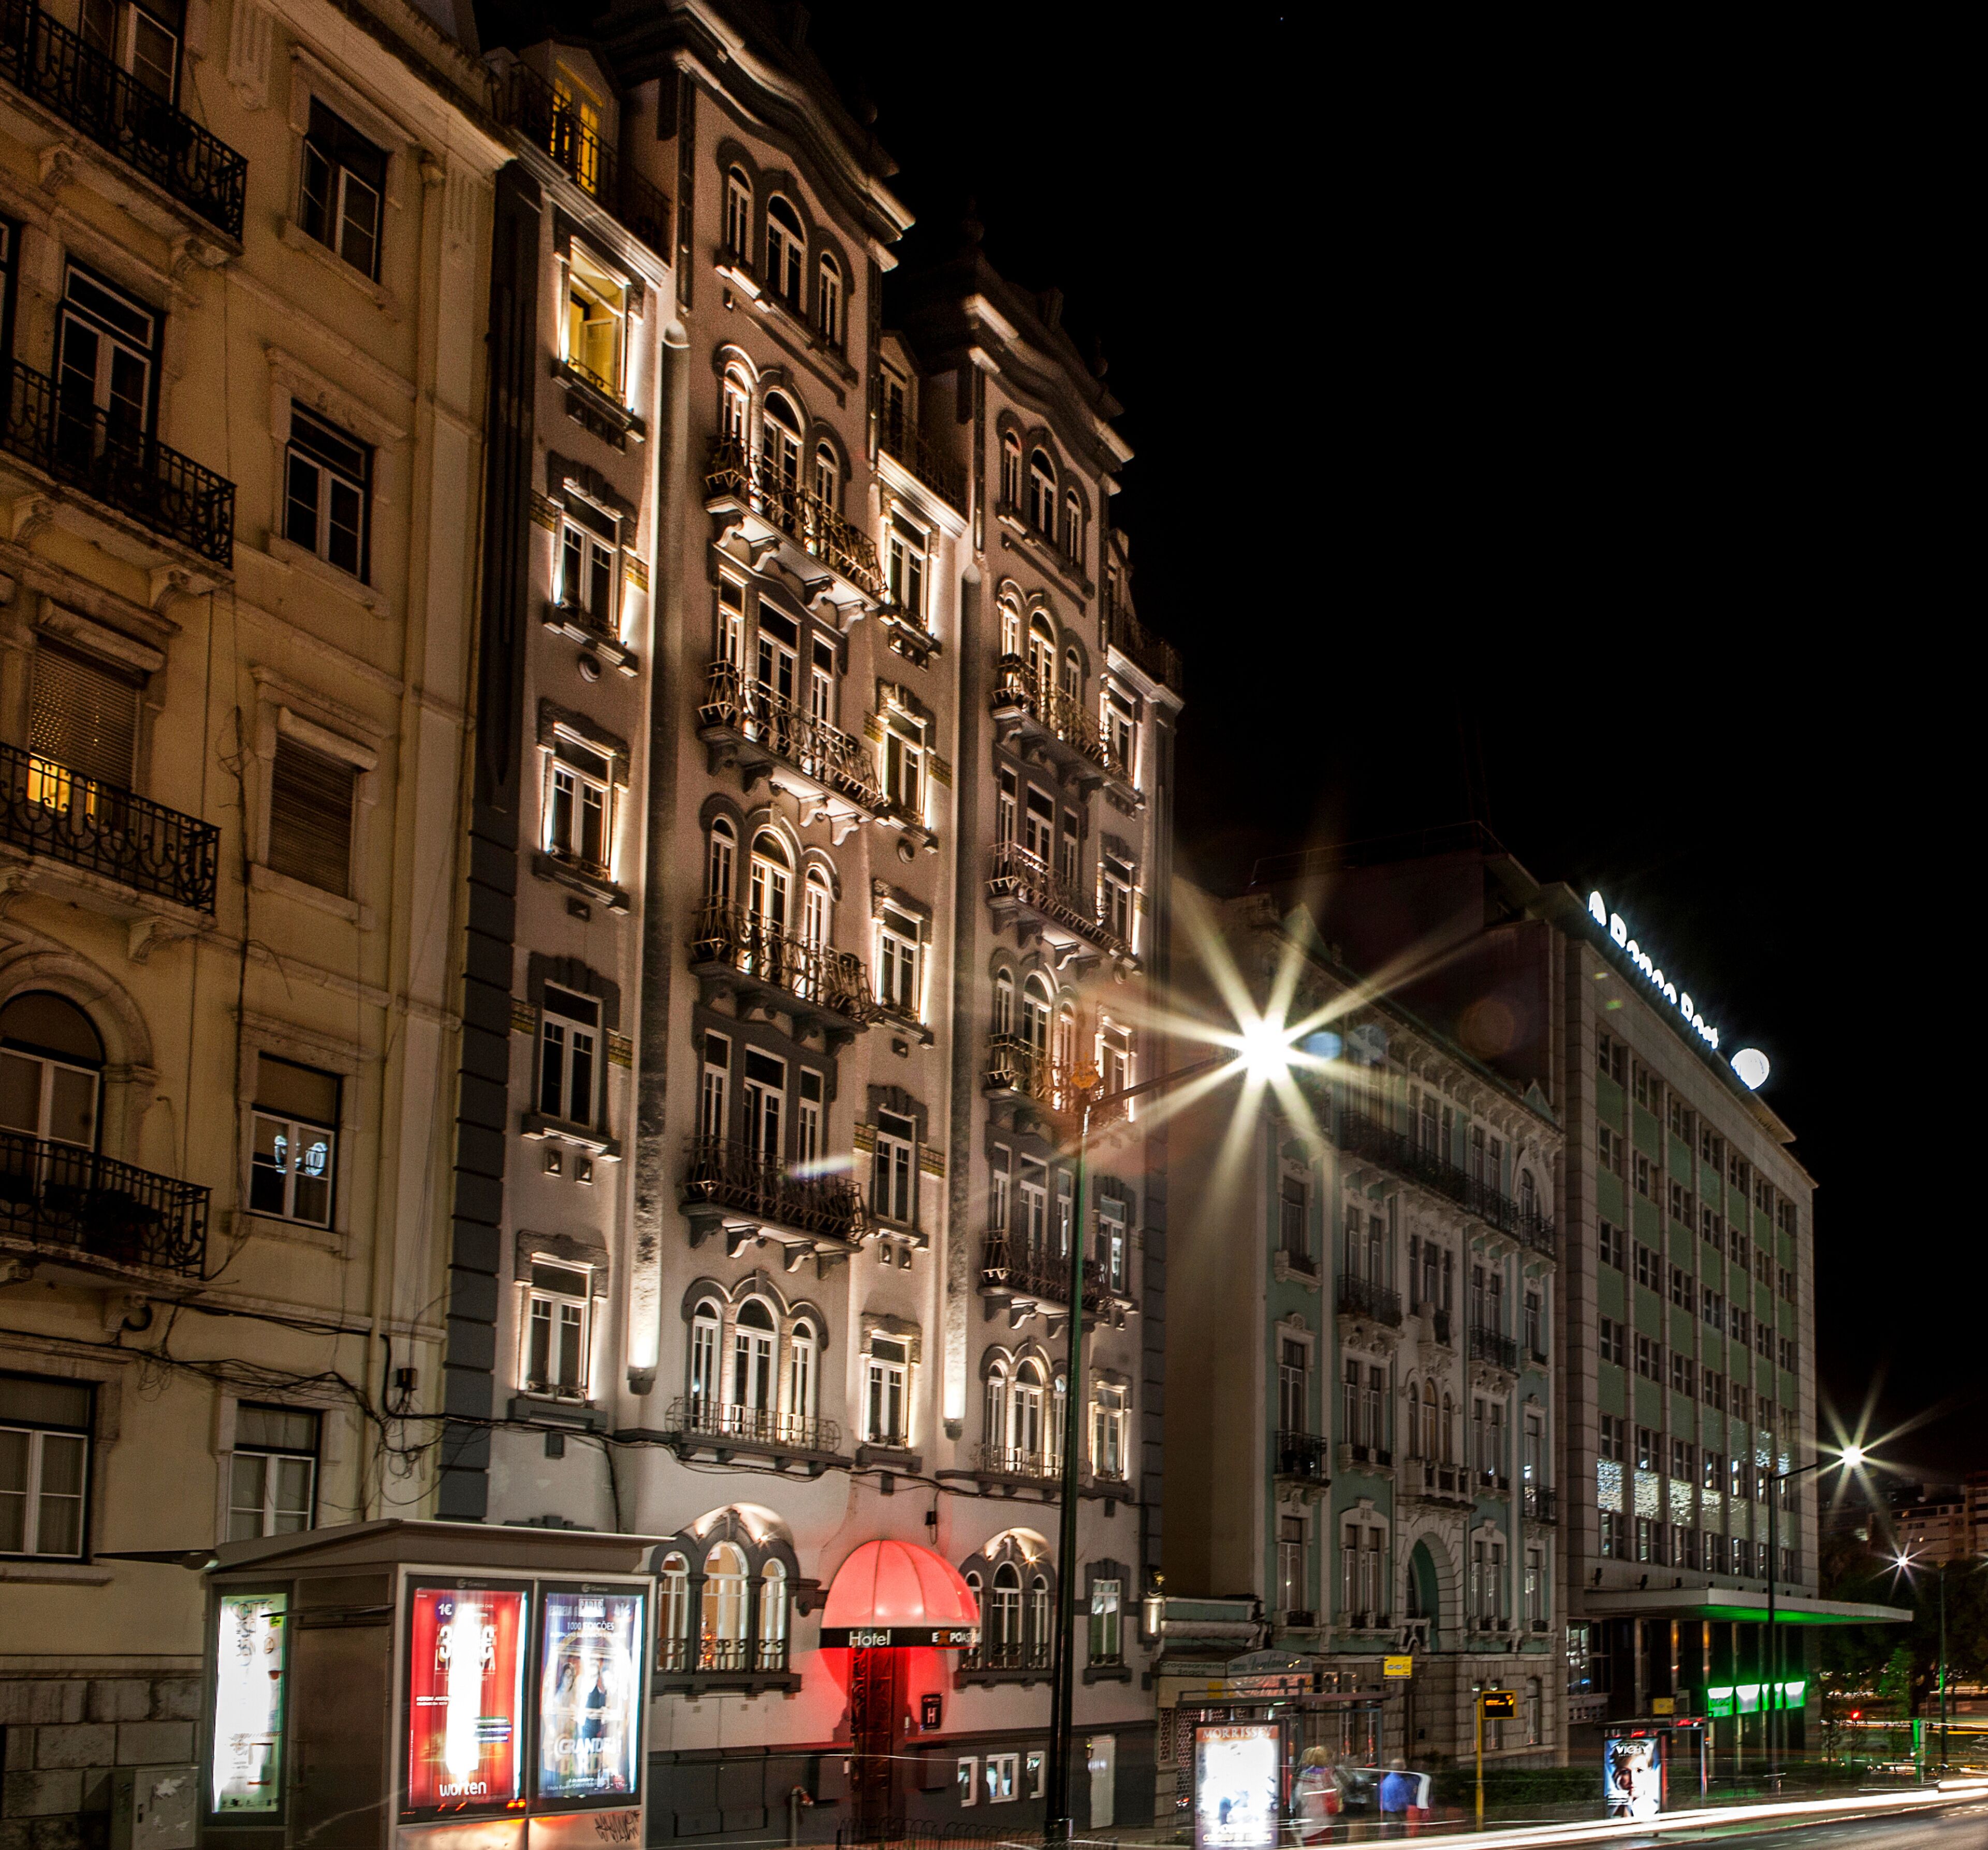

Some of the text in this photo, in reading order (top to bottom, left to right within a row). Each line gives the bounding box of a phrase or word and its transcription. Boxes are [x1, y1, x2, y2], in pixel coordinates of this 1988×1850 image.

[438, 1603, 452, 1616] 1€
[567, 1622, 581, 1630] 1000
[849, 1629, 891, 1646] Hotel
[927, 1708, 937, 1723] H
[1202, 1726, 1273, 1739] MORRISSEY
[1616, 1744, 1648, 1754] VICHY
[439, 1781, 487, 1797] worten
